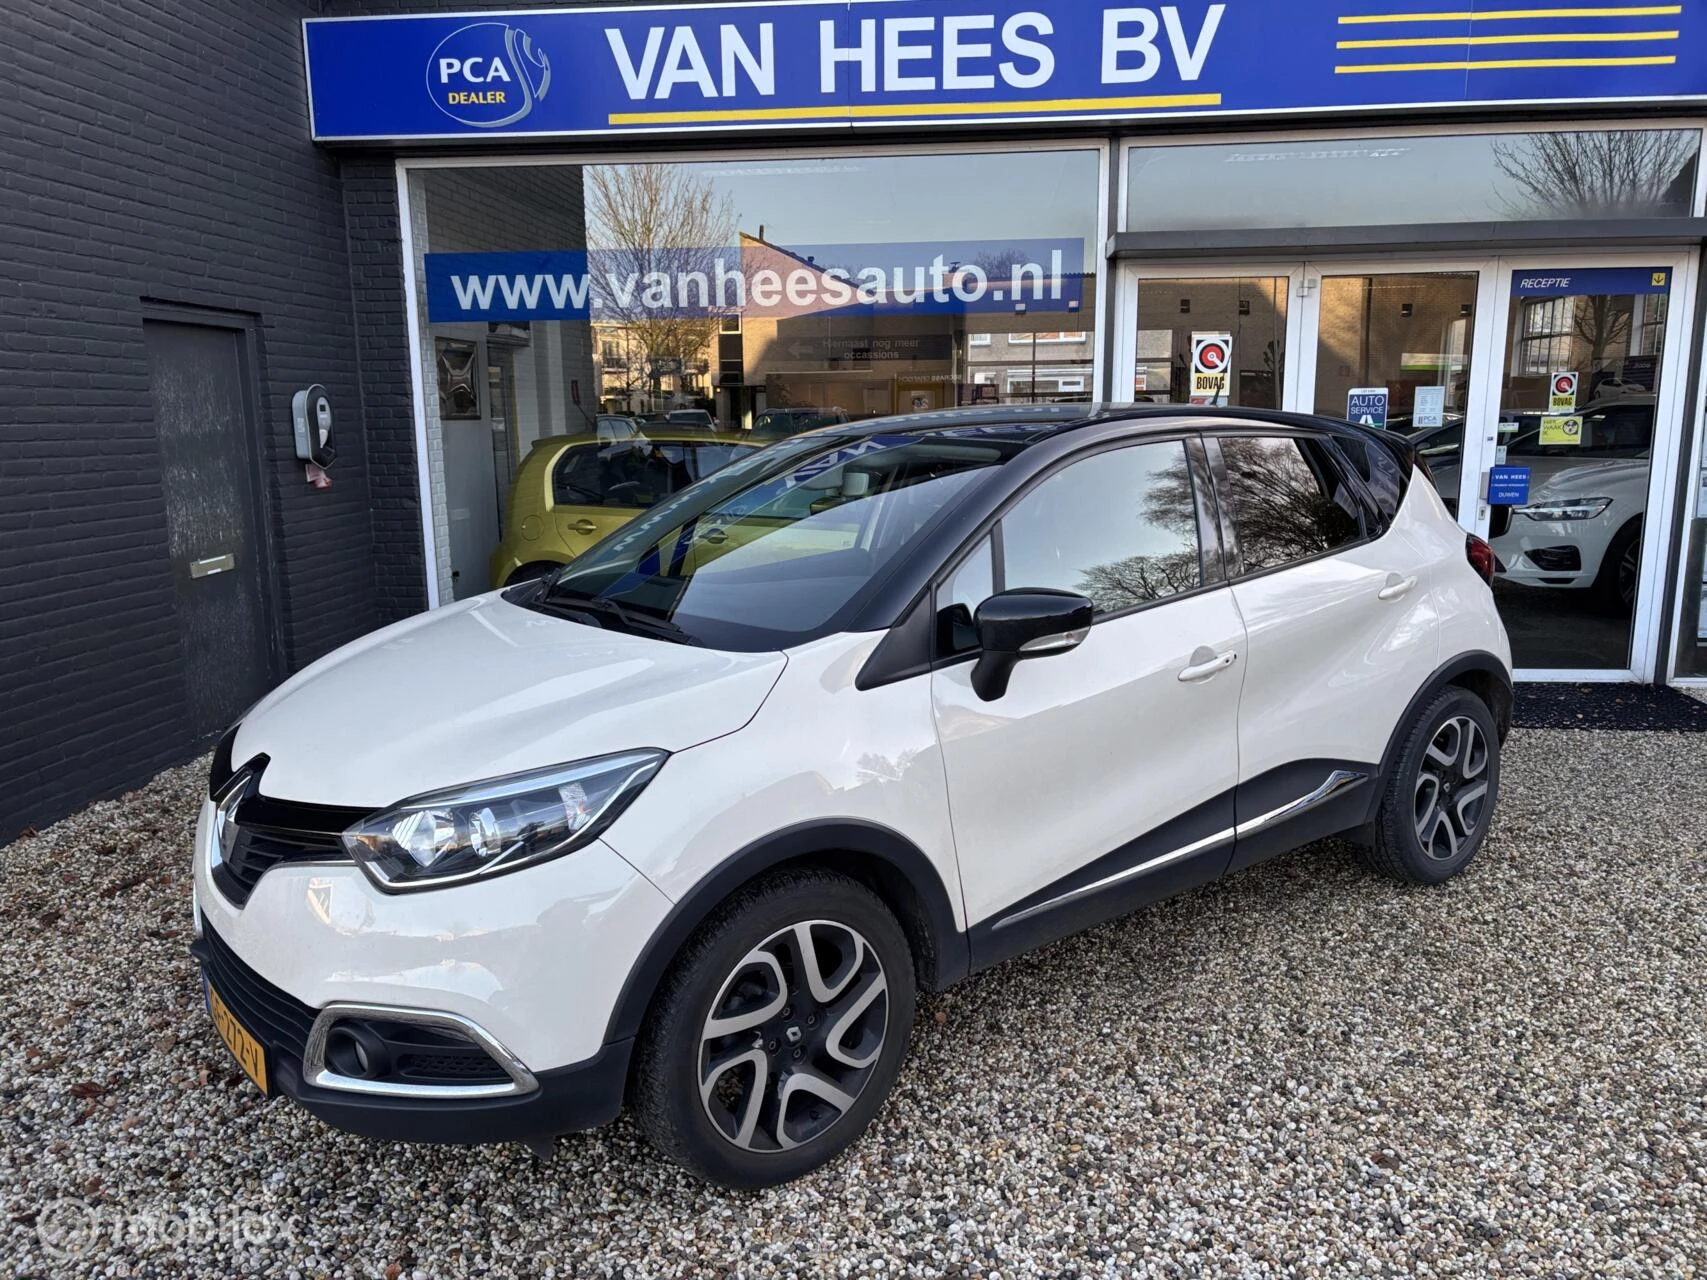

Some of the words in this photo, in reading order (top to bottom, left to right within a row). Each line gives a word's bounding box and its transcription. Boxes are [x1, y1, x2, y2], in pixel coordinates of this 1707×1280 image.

[604, 22, 775, 100] VAN
[819, 11, 1055, 93] HEES
[1101, 3, 1226, 84] BV
[439, 57, 511, 83] PCA
[448, 91, 506, 105] DEALER
[450, 250, 1063, 310] www.vanheesauto.nl
[1520, 277, 1571, 288] RECEPTIE
[1196, 376, 1225, 390] BOVAG
[1350, 395, 1385, 406] AUTO
[1552, 397, 1573, 407] BOVAG
[1350, 406, 1384, 415] SERVICE
